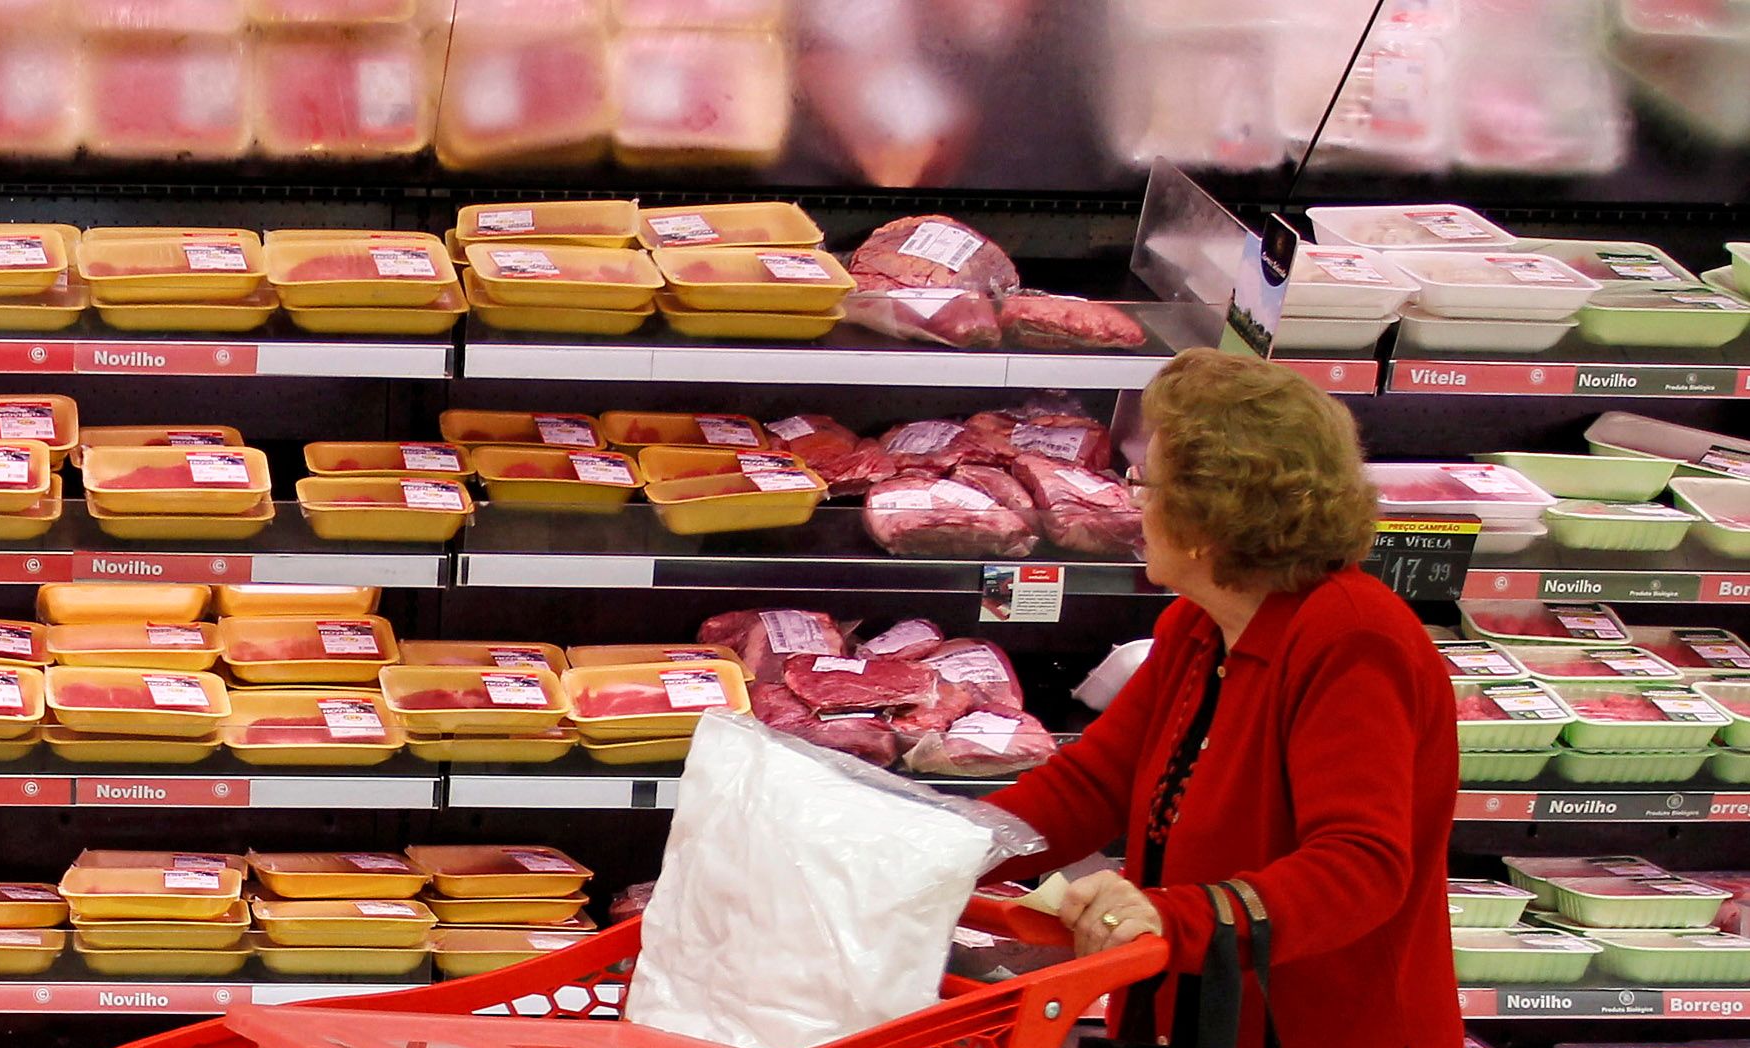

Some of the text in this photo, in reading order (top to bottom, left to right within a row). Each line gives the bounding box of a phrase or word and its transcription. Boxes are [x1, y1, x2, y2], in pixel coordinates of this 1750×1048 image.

[94, 350, 166, 367] Novilho
[1410, 369, 1467, 386] Vitela
[1578, 373, 1637, 388] Novilho
[92, 558, 163, 576] Novilho
[1544, 579, 1602, 593] Novilho
[96, 784, 166, 799] Novilho
[1548, 800, 1617, 814] Novilho
[99, 991, 169, 1007] Novilho
[1507, 994, 1573, 1009] Novilho
[1670, 997, 1744, 1015] Borrego
